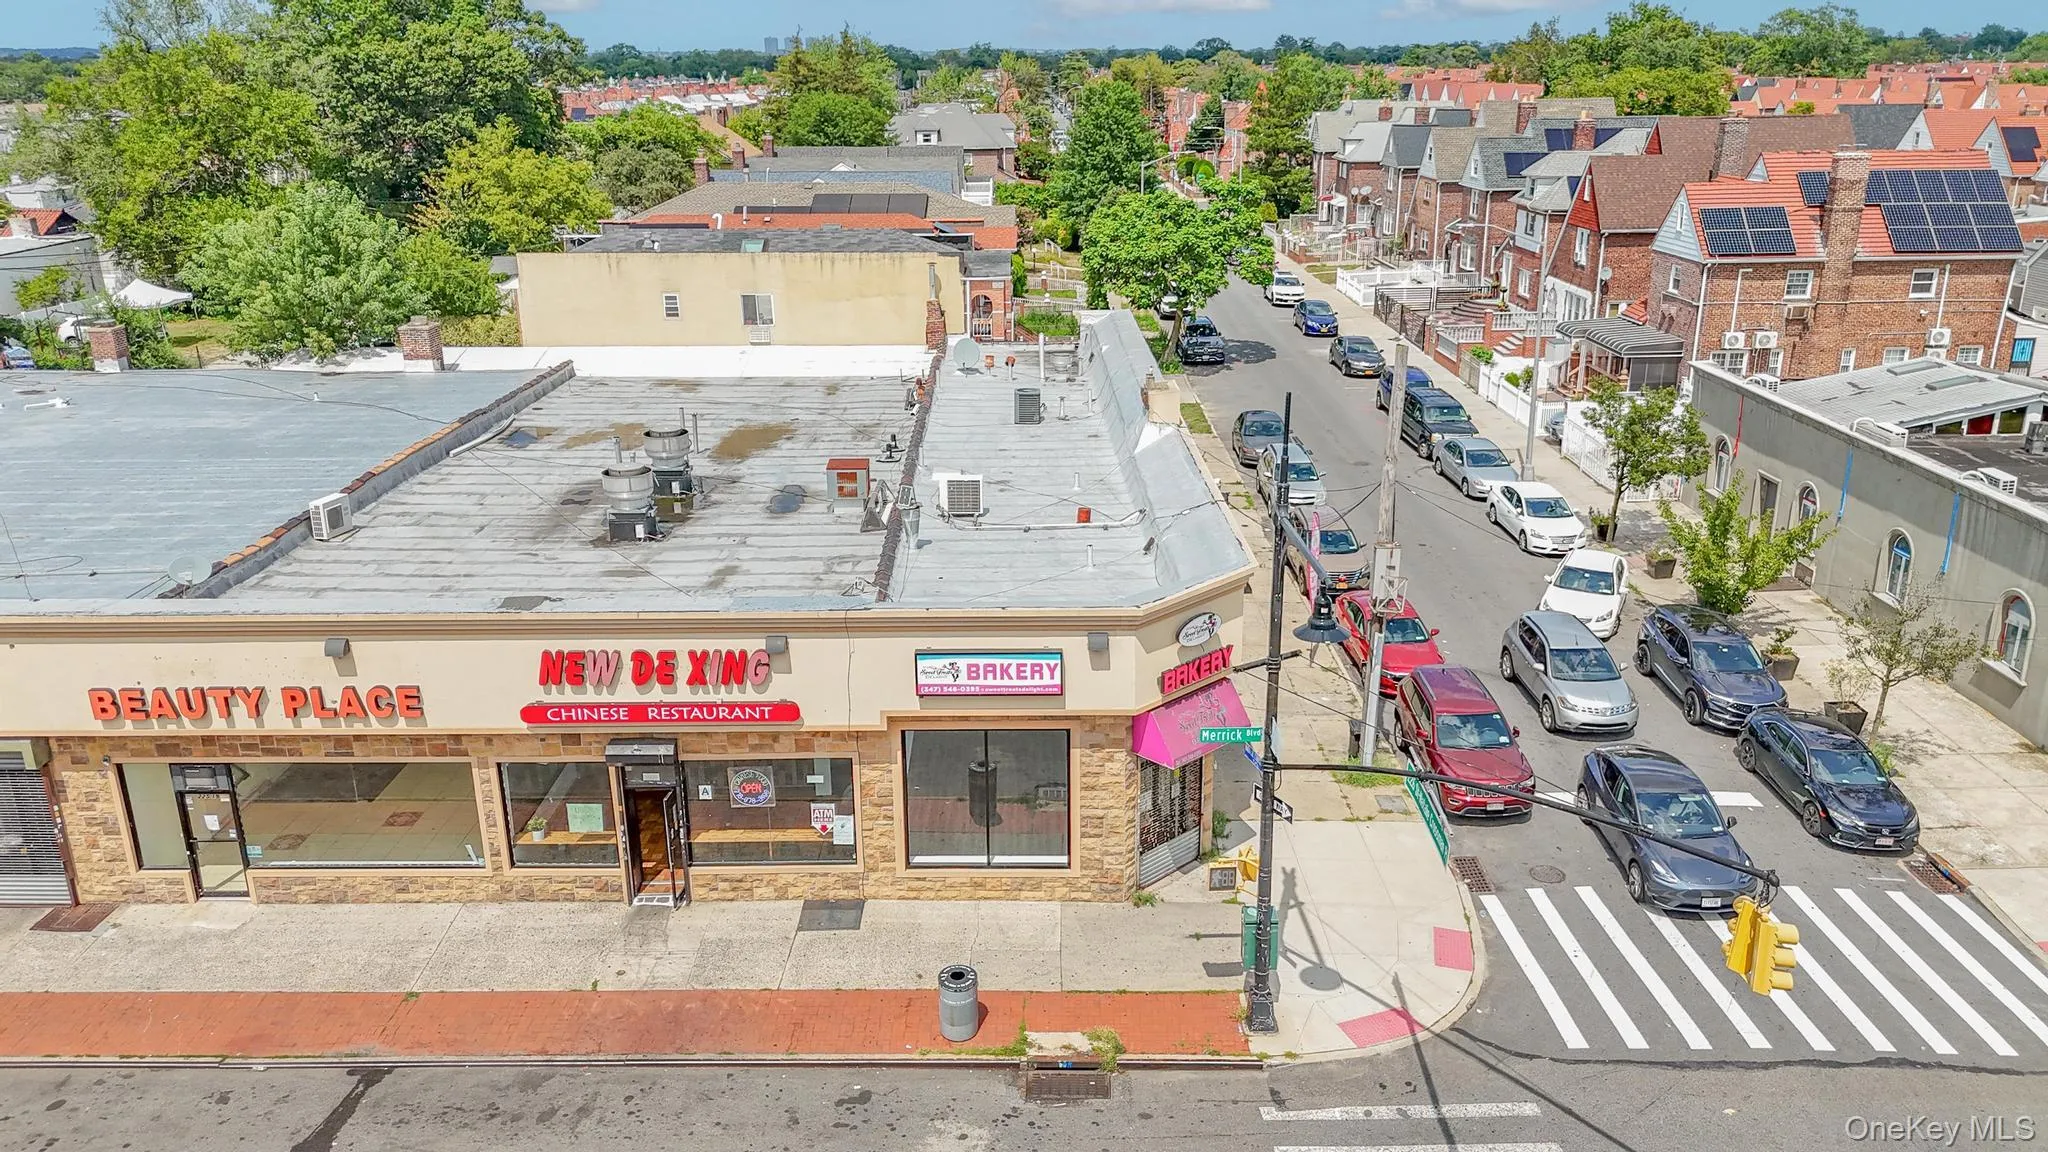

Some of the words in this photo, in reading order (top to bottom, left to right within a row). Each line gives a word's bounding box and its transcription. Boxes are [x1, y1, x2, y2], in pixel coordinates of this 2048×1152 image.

[538, 649, 622, 686] NEW
[631, 649, 677, 686] DE
[685, 649, 770, 686] XING
[966, 663, 1060, 681] BAKERY
[1162, 645, 1233, 695] BAKERY
[920, 686, 941, 695] (347)
[87, 686, 266, 721] BEAUTY
[280, 685, 424, 720] PLACE
[547, 707, 628, 721] CHINESE
[648, 706, 773, 720] RESTAURANT
[1202, 729, 1242, 741] Merrick
[1246, 729, 1261, 737] Blvd
[701, 787, 709, 796] A
[740, 782, 762, 794] OPEN
[814, 809, 833, 818] ATM
[1276, 802, 1289, 814] WAY
